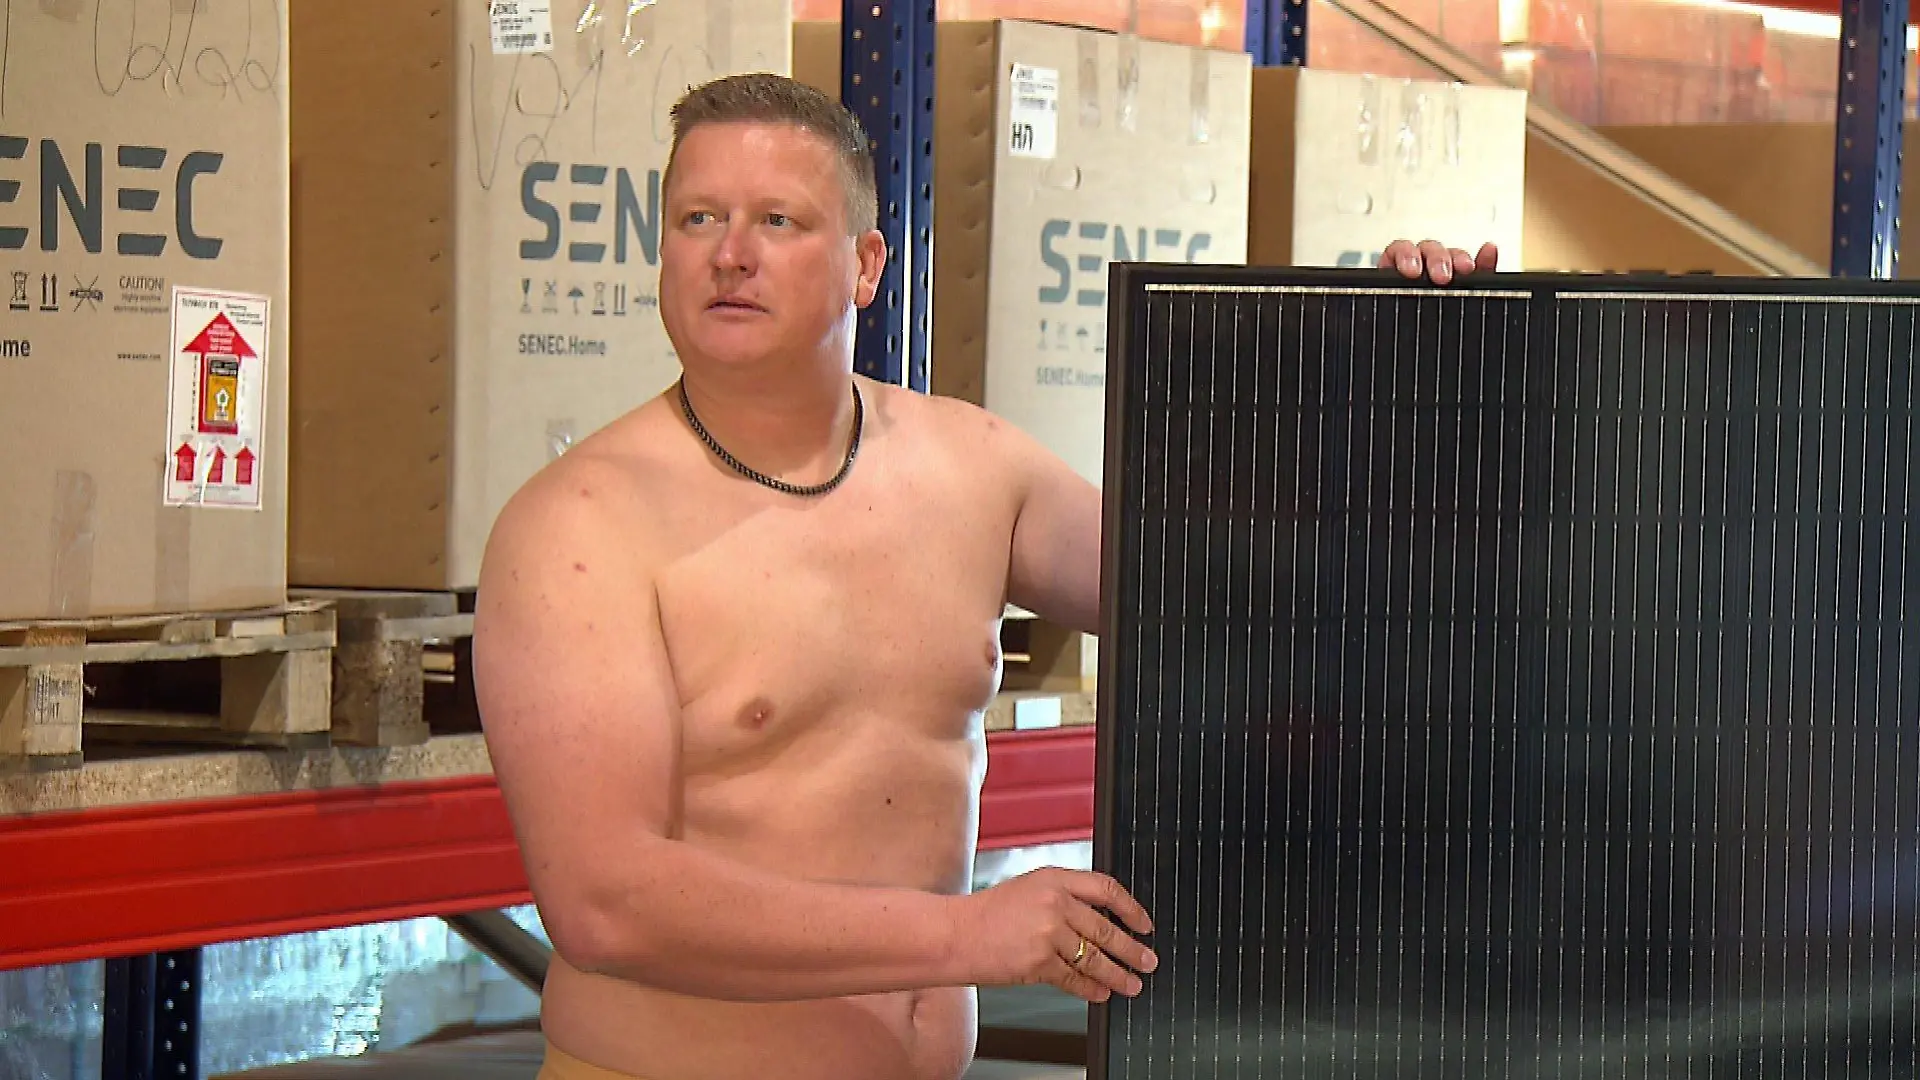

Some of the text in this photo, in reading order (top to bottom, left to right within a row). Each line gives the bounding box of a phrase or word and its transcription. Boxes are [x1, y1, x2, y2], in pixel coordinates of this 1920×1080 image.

[0, 134, 224, 260] ENEC
[519, 161, 660, 266] SEN
[119, 276, 164, 291] CAUTION!
[0, 339, 30, 357] me
